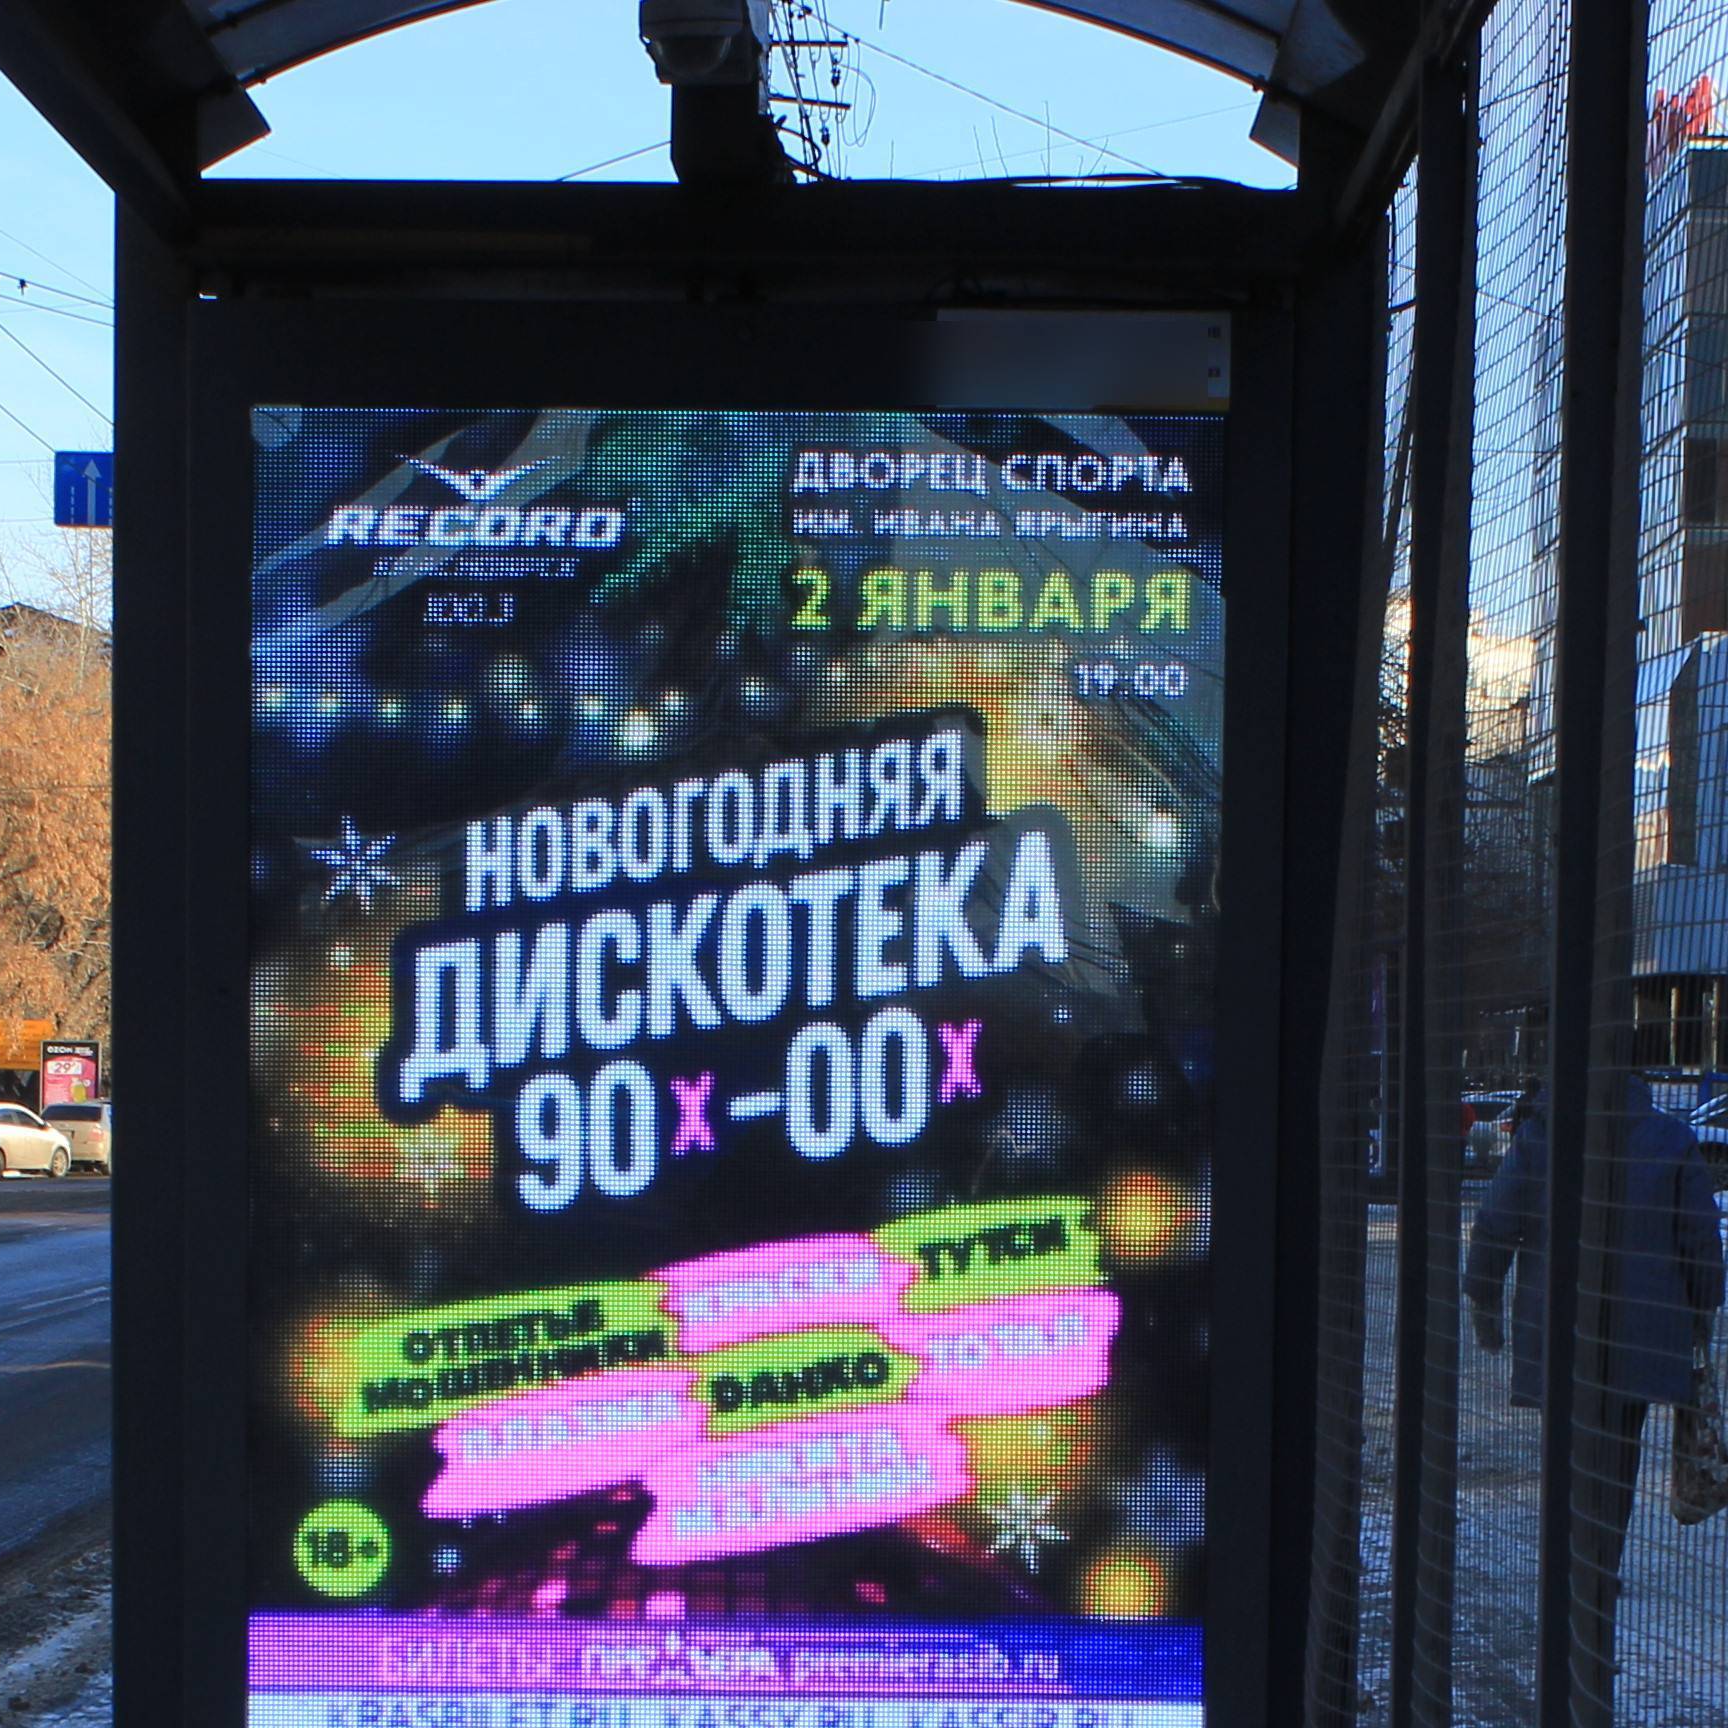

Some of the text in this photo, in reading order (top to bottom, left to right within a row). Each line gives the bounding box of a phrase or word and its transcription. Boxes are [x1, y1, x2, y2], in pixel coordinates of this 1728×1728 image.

[791, 451, 1193, 497] ДВОРЕЦ СПОРТА
[323, 505, 627, 549] RECORD
[871, 510, 1003, 538] ИВАНА
[789, 566, 1192, 634] 2 ЯНВАРЯ
[1076, 661, 1189, 697] 19:00
[464, 728, 964, 913] НОВОГОДНЯЯ
[398, 829, 1070, 1104] ДИСКОТЕКА
[304, 1531, 382, 1570] 18+
